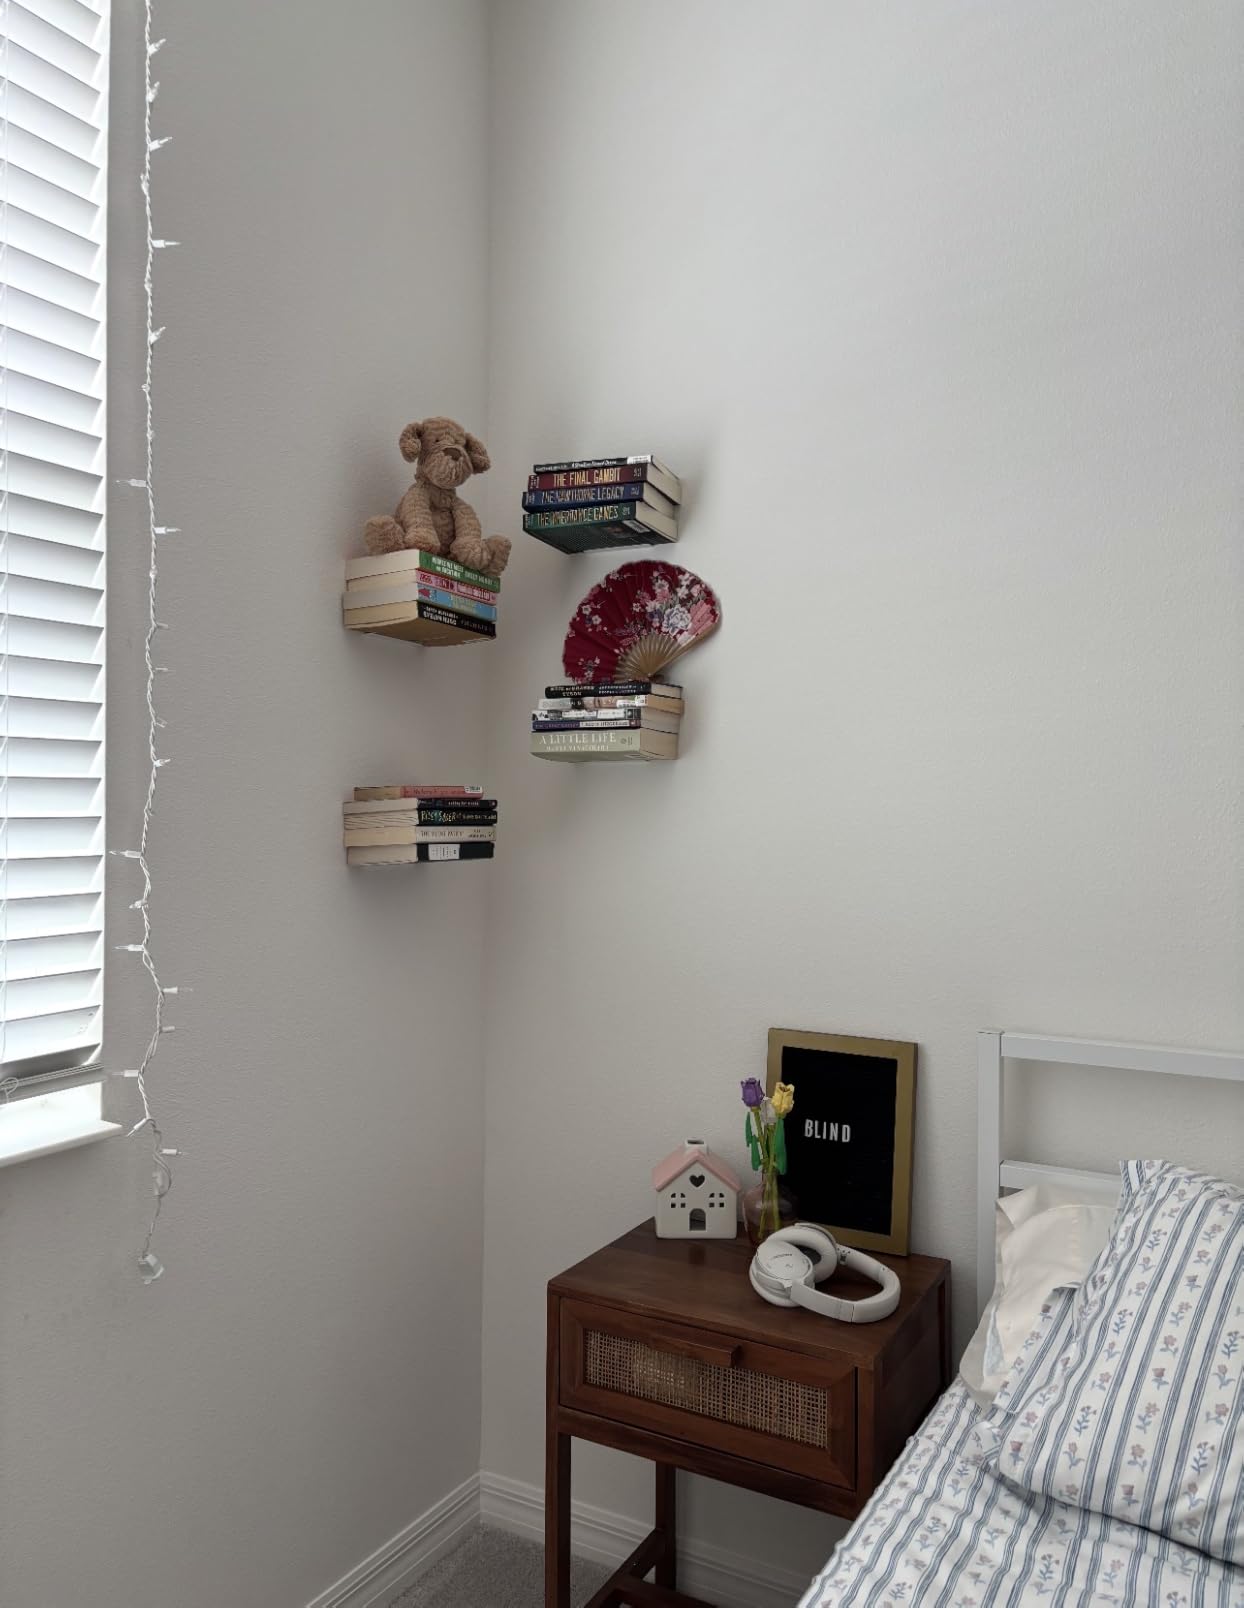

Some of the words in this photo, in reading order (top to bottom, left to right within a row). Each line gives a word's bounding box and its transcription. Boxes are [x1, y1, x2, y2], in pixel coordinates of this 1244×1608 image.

[553, 472, 567, 487] THE
[569, 470, 591, 485] FINAL
[593, 467, 622, 484] GAMBIT
[597, 484, 625, 500] LEGACY
[537, 512, 549, 526] THE
[593, 505, 619, 521] GAMES
[538, 735, 547, 744] A
[550, 733, 590, 744] LITTLE
[591, 732, 617, 744] LIFE
[804, 1118, 851, 1143] BLIND
